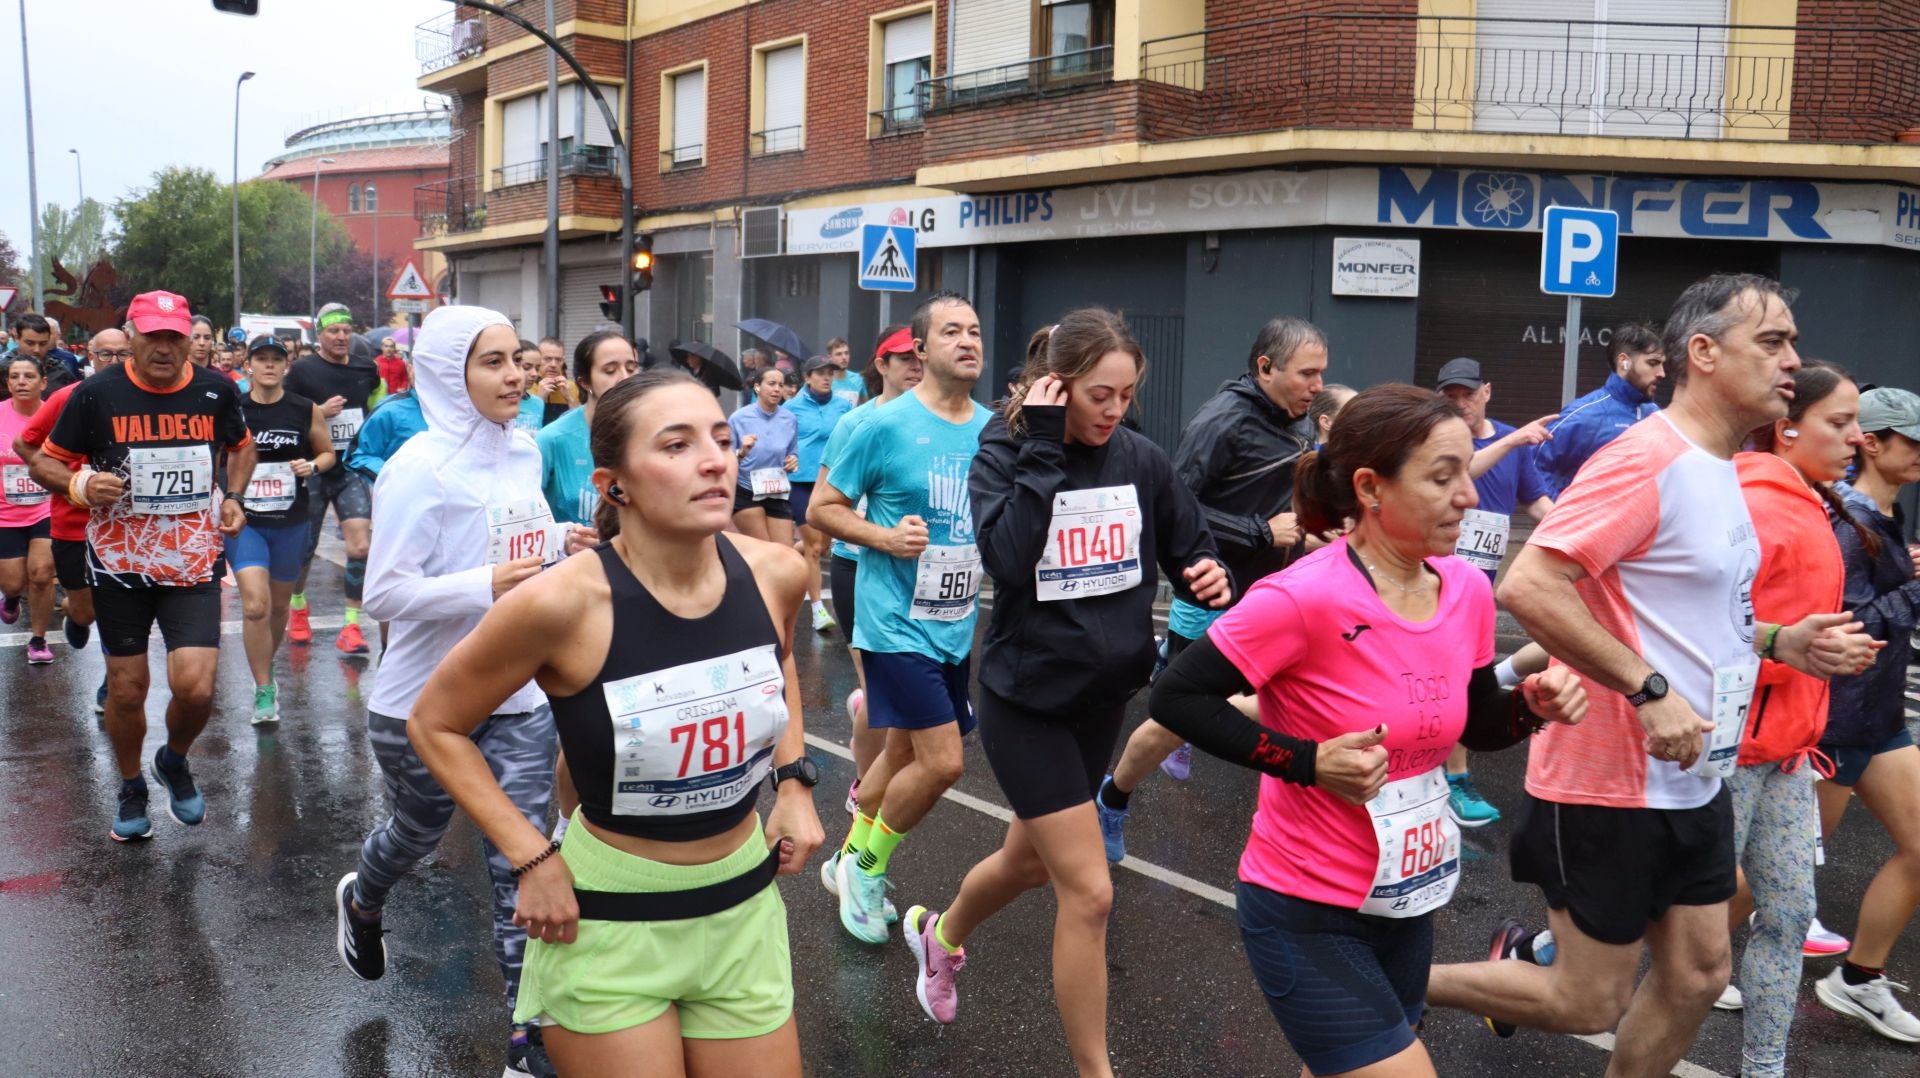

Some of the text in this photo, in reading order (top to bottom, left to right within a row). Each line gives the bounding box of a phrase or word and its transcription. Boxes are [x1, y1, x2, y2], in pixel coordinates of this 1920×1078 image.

[1080, 183, 1156, 220] JVC
[1188, 176, 1308, 210] SONY
[1377, 166, 1832, 240] MONFER
[909, 208, 935, 233] LG
[958, 190, 1054, 229] PHILIPS
[826, 216, 863, 231] SAMSUN
[789, 240, 854, 252] SERVICIO
[1559, 218, 1603, 285] P
[1338, 262, 1417, 275] MONFER
[112, 414, 215, 443] VALDEÓN
[331, 423, 356, 439] 670
[152, 470, 194, 496] 729
[251, 479, 283, 498] 709
[762, 479, 782, 493] 702
[509, 529, 545, 562] 1137
[1057, 522, 1126, 568] 1040
[1473, 529, 1502, 554] 748
[938, 570, 972, 600] 961
[1083, 574, 1127, 589] HYUNDAI
[676, 697, 738, 721] CRISTINA
[669, 710, 746, 779] 781
